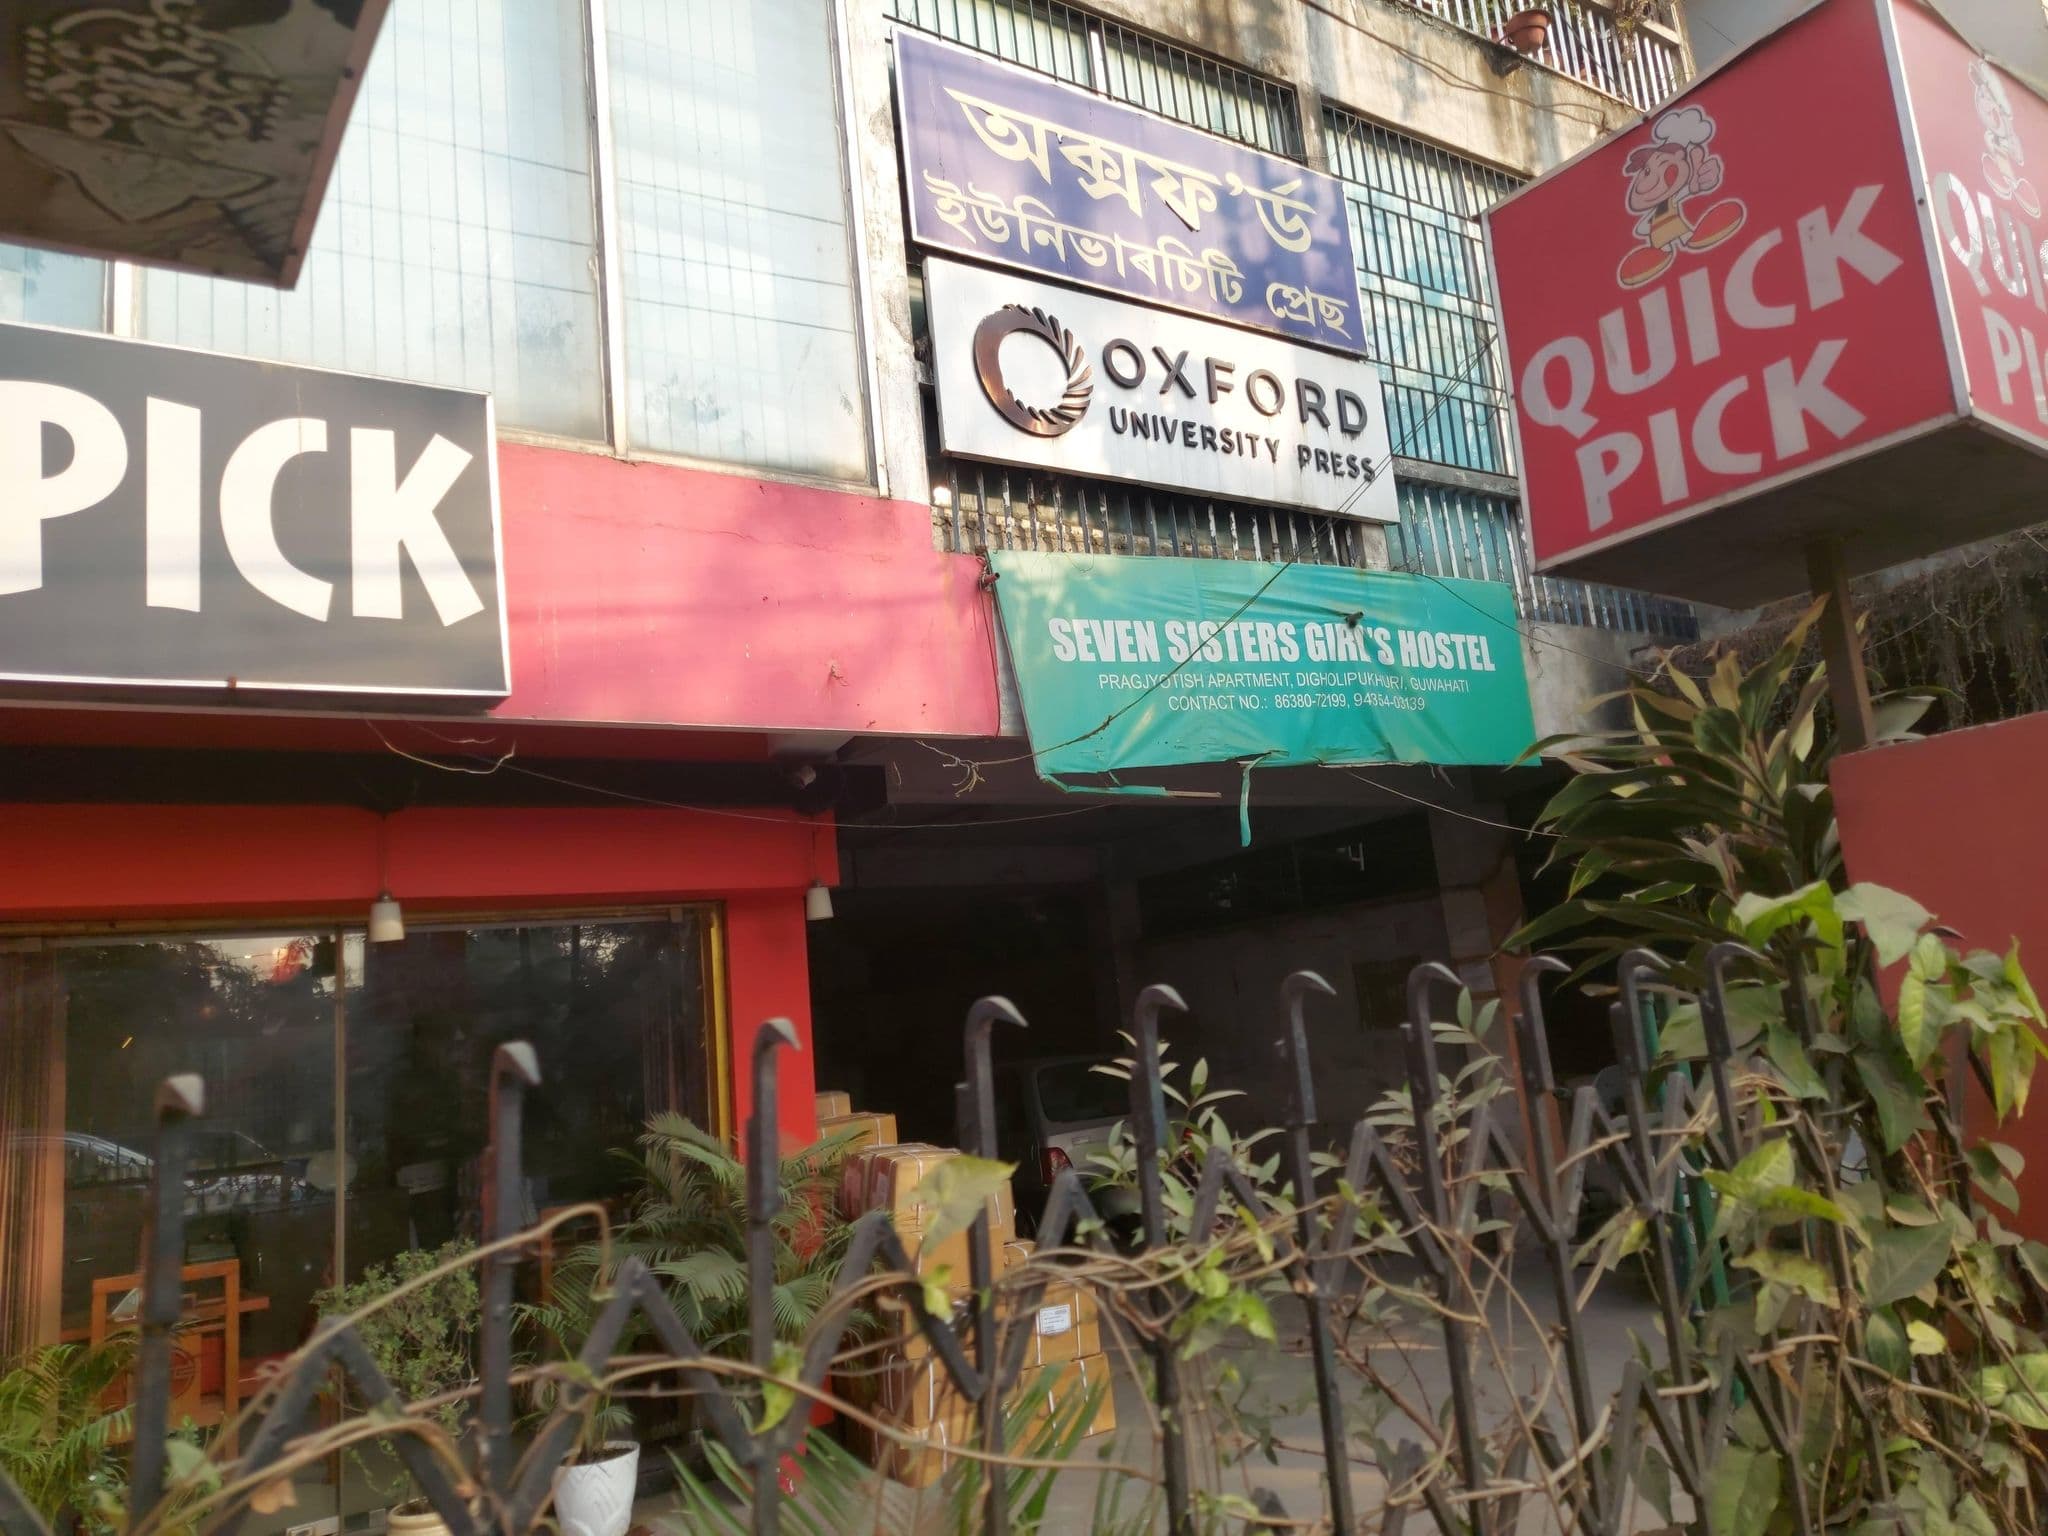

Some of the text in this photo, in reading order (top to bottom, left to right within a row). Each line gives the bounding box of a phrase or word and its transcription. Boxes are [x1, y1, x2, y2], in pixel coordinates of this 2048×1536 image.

[1932, 171, 2048, 313] QUI
[1521, 184, 1904, 439] QUICK
[1102, 338, 1369, 435] OXFORD
[1982, 307, 2048, 425] PI
[1109, 406, 1376, 483] UNIVERSITY PRESS
[1575, 338, 1867, 532] PICK
[0, 380, 485, 627] PICK
[1048, 617, 1161, 663] SEVEN
[1165, 620, 1300, 664] SISTERS
[1398, 629, 1497, 672] HOSTEL
[1098, 673, 1204, 690] PRAGJYOTISH
[1208, 672, 1294, 690] APARTMENT,
[1410, 677, 1470, 694] GUWAHATI
[1168, 694, 1235, 711] CONTACT
